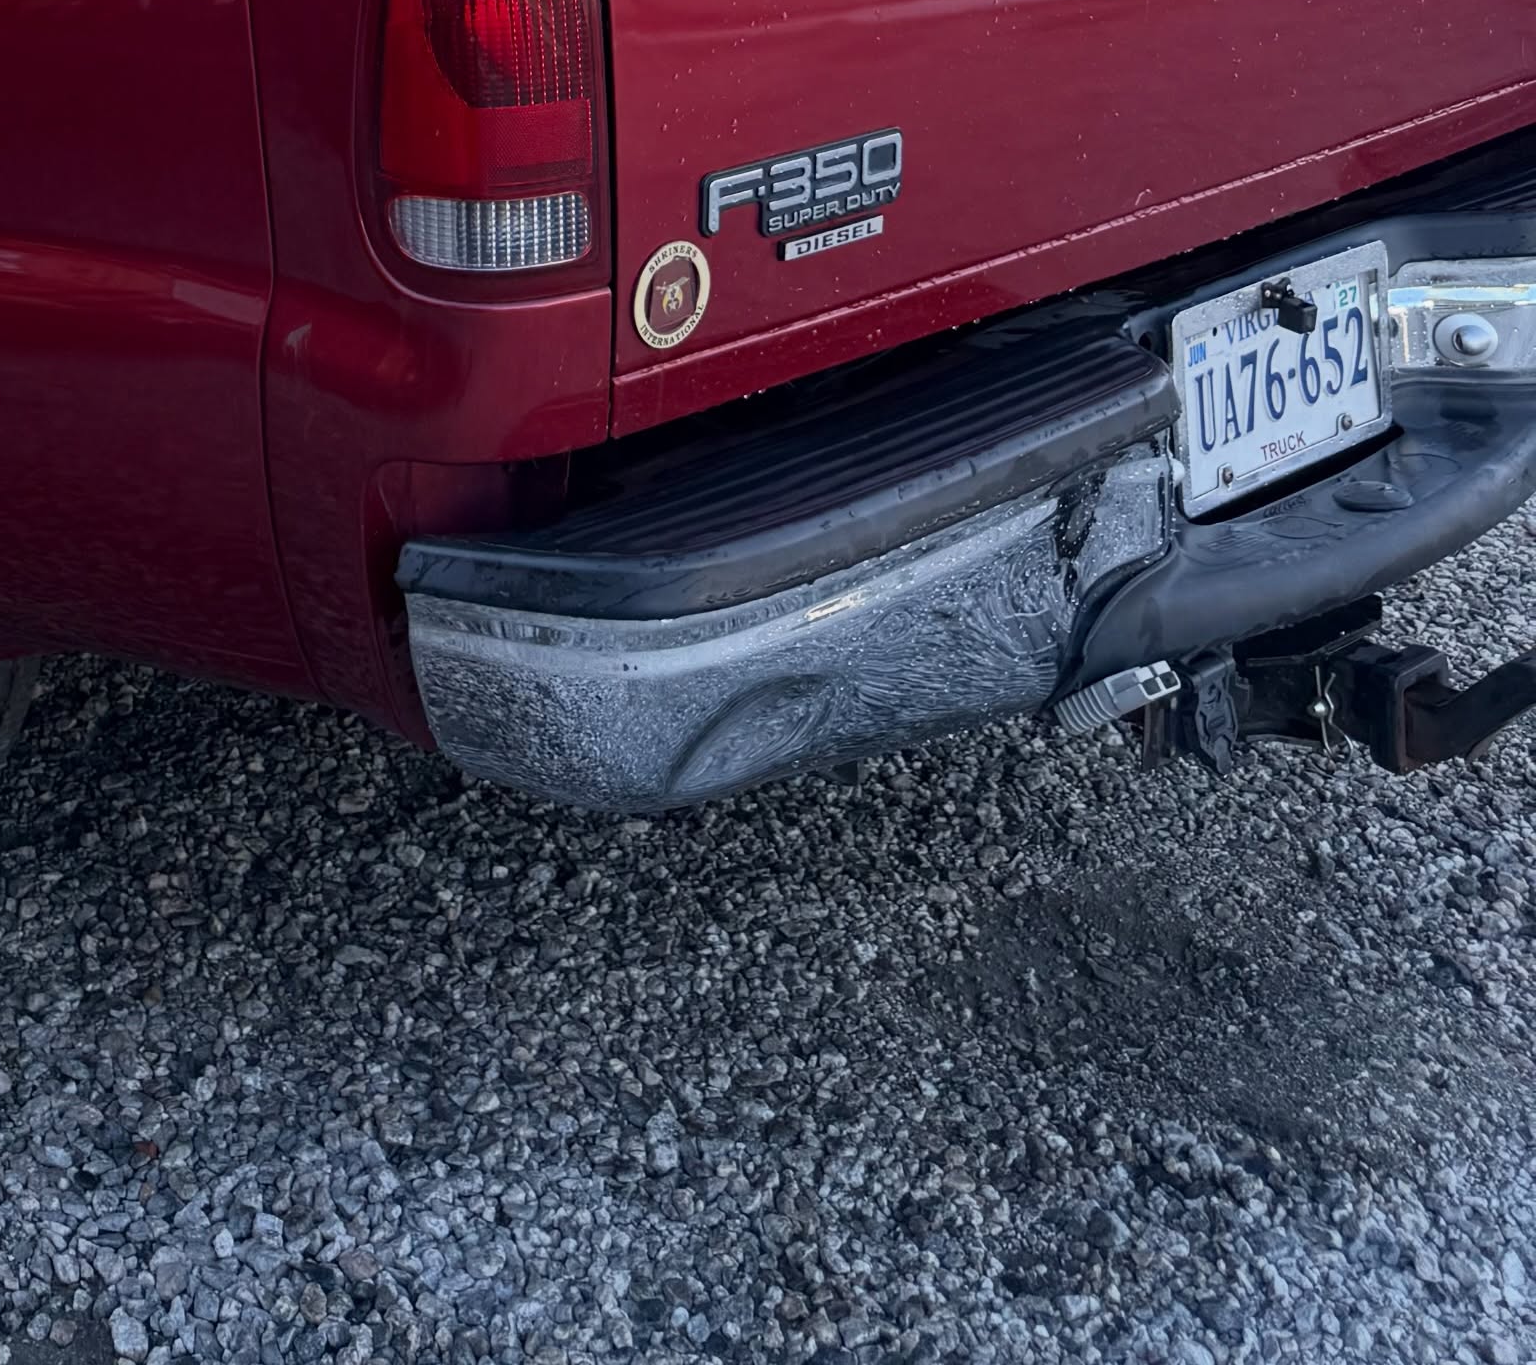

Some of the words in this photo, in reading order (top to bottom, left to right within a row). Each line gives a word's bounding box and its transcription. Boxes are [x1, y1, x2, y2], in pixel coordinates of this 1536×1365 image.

[768, 200, 845, 234] SUPER
[846, 182, 901, 211] DUTY
[795, 220, 878, 256] DIESEL
[648, 244, 698, 274] SHRINERS
[1338, 285, 1358, 308] 27
[639, 303, 705, 347] INTERNATIONAL
[1187, 340, 1207, 368] JUN
[1260, 431, 1307, 463] TRUCK
